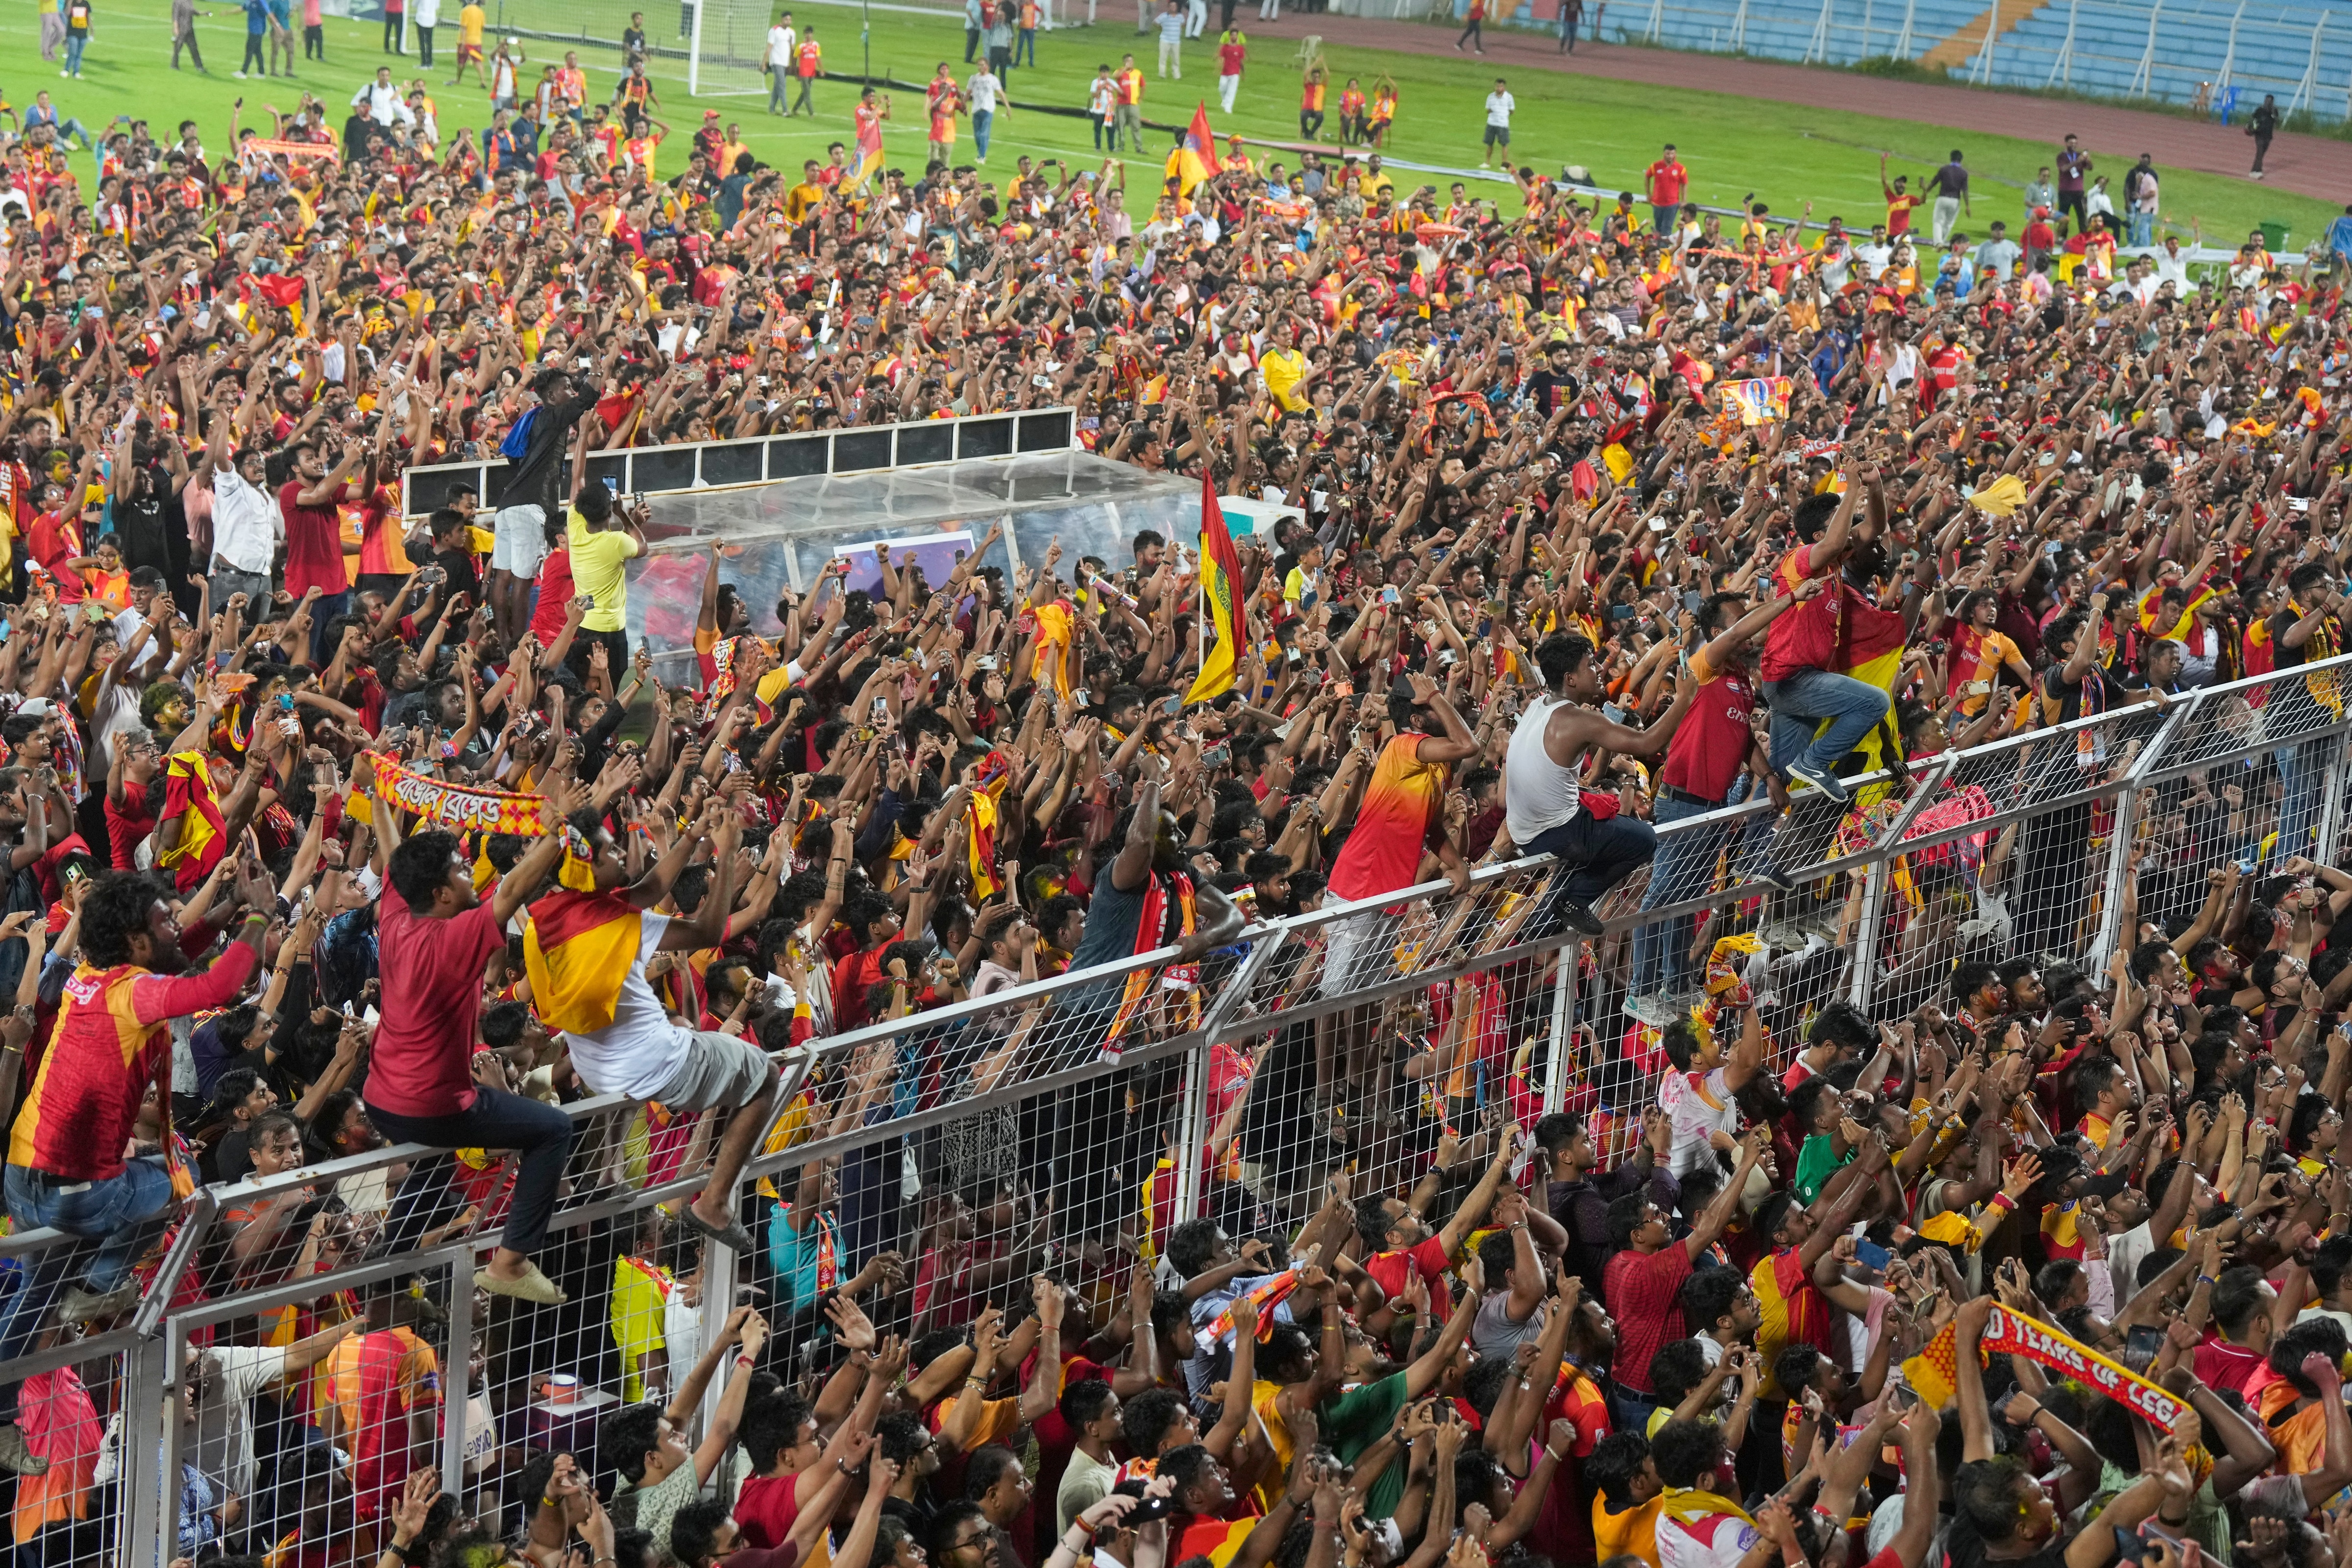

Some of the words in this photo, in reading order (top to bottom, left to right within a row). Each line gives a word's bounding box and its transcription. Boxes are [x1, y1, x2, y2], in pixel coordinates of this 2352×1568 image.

[395, 774, 443, 812] বাঙাল
[2009, 1318, 2086, 1372] YEARS
[2092, 1362, 2120, 1390] OF
